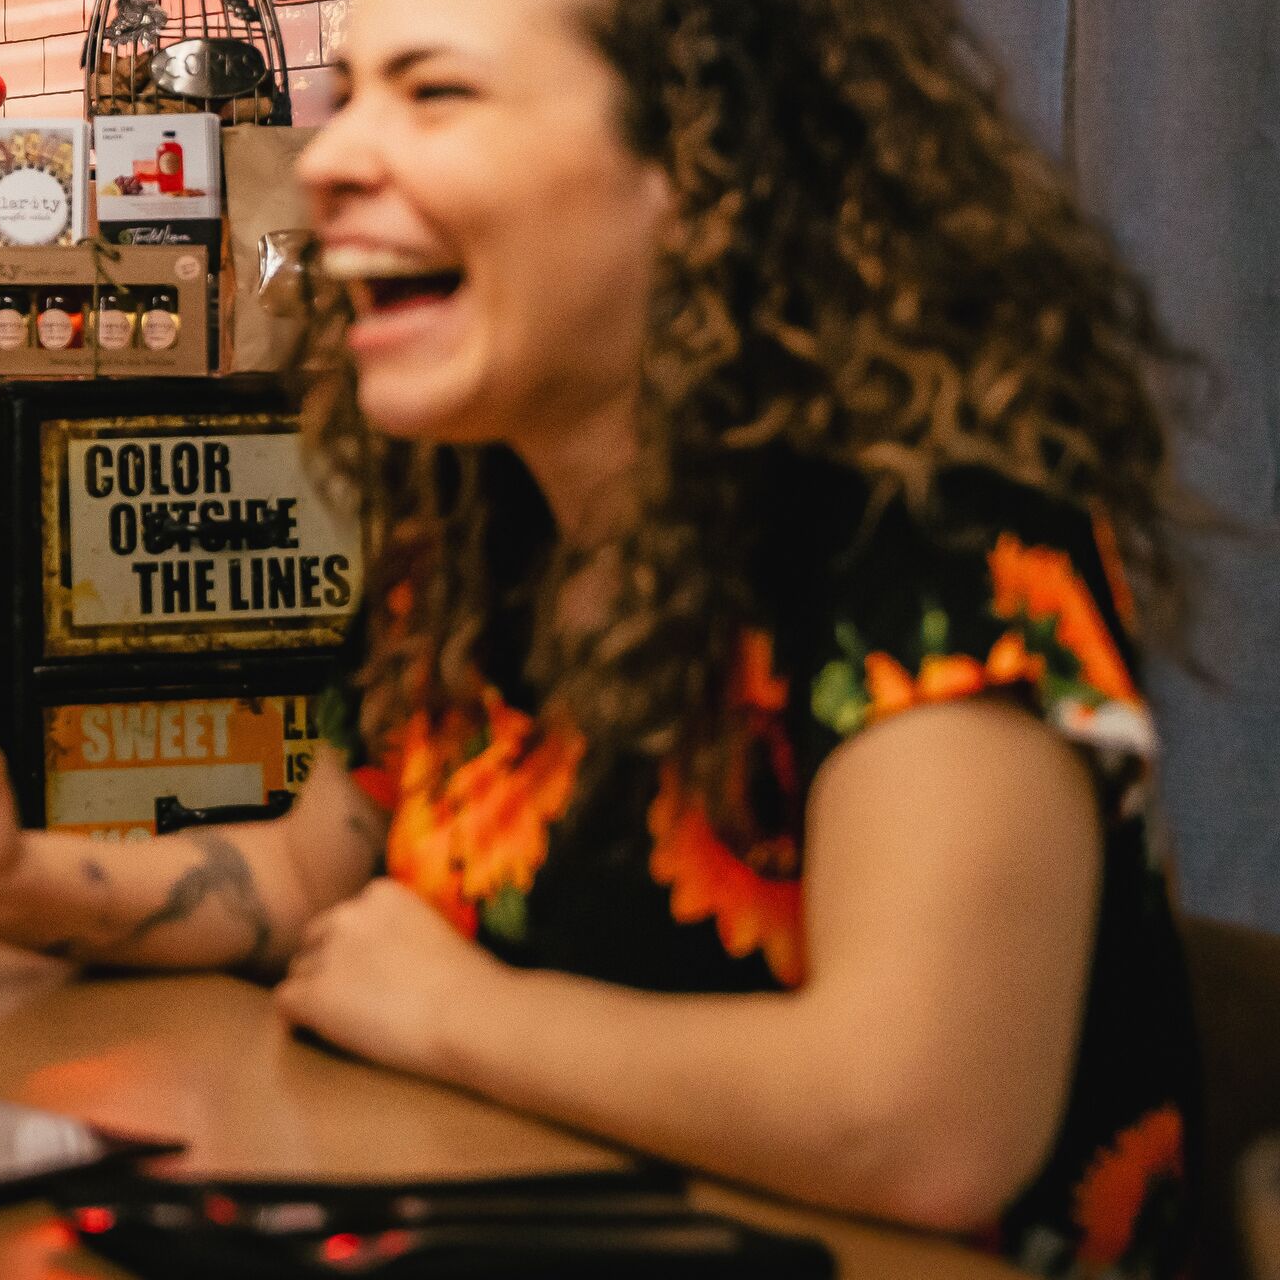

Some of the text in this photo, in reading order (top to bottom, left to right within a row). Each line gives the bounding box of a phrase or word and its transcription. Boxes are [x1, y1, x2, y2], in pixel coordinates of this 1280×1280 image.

[84, 442, 231, 498] COLOR
[109, 497, 299, 555] OUTSIDE
[132, 554, 351, 614] THE LINES
[80, 702, 233, 762] SWEET
